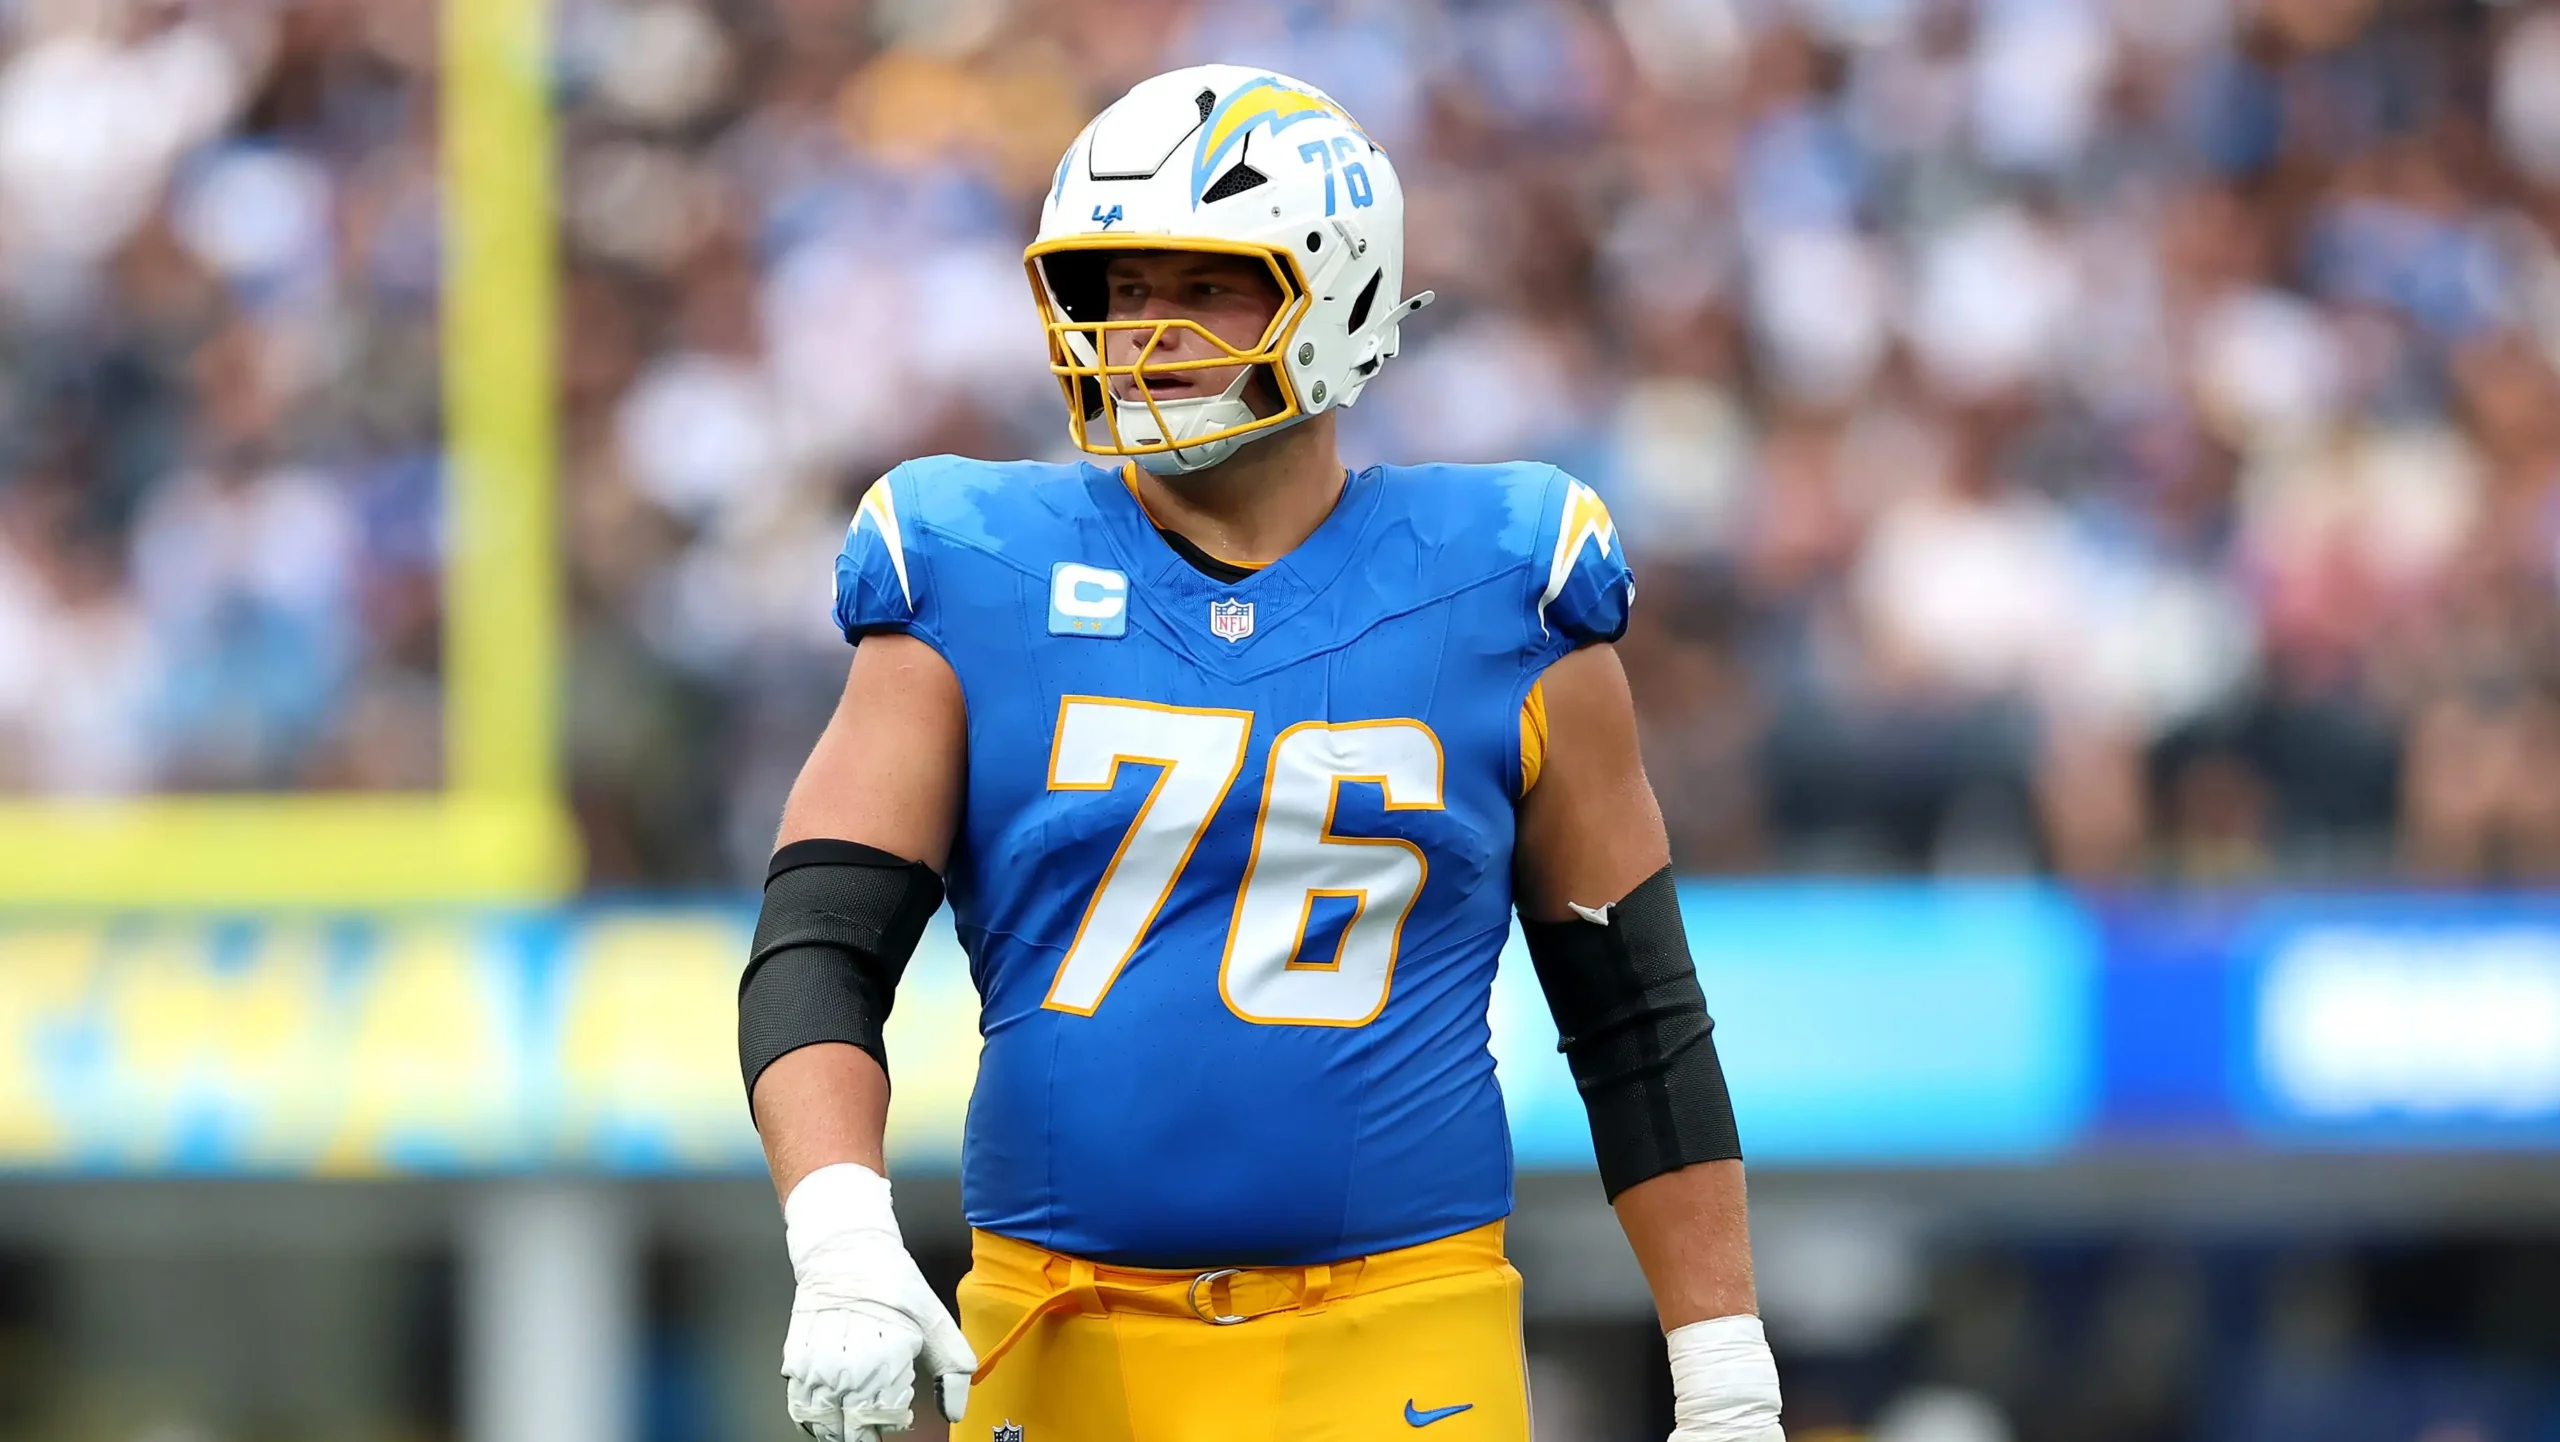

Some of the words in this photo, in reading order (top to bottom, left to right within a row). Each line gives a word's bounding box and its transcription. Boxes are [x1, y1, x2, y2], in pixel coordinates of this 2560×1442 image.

[1297, 136, 1373, 217] 76
[1091, 204, 1123, 226] LA
[1054, 564, 1126, 618] C
[1218, 616, 1247, 633] NFL
[1040, 695, 1446, 1028] 76
